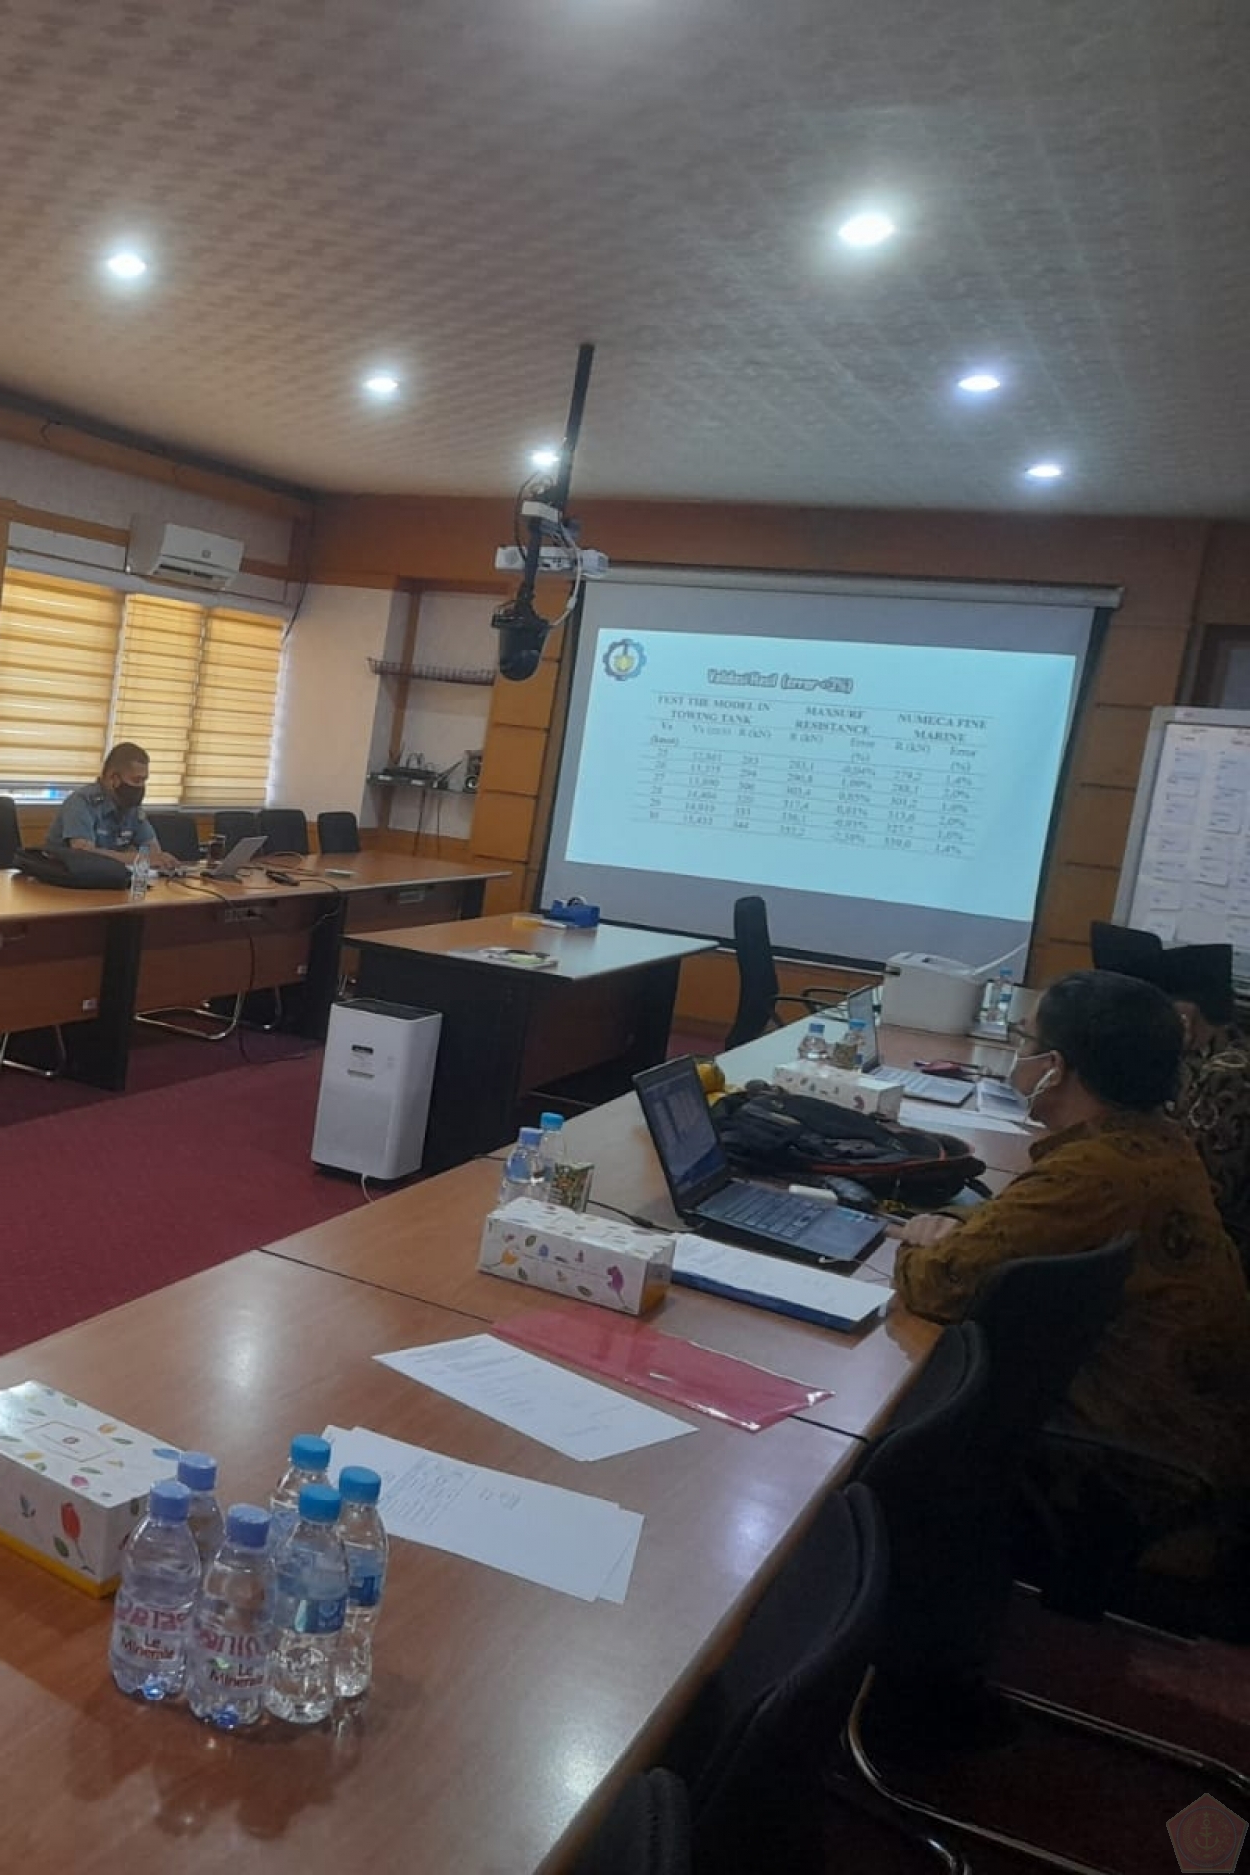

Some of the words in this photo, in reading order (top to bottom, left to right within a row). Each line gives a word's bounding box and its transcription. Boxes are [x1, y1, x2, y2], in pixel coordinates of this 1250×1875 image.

[688, 698, 708, 707] THE
[714, 699, 753, 711] MODEL
[758, 702, 770, 712] IN
[672, 710, 717, 722] TOWING
[722, 713, 751, 724] TANK
[898, 713, 953, 727] NUMECA
[957, 718, 987, 729] FINE
[795, 720, 870, 735] RESISTANCE
[914, 729, 965, 742] MARINE
